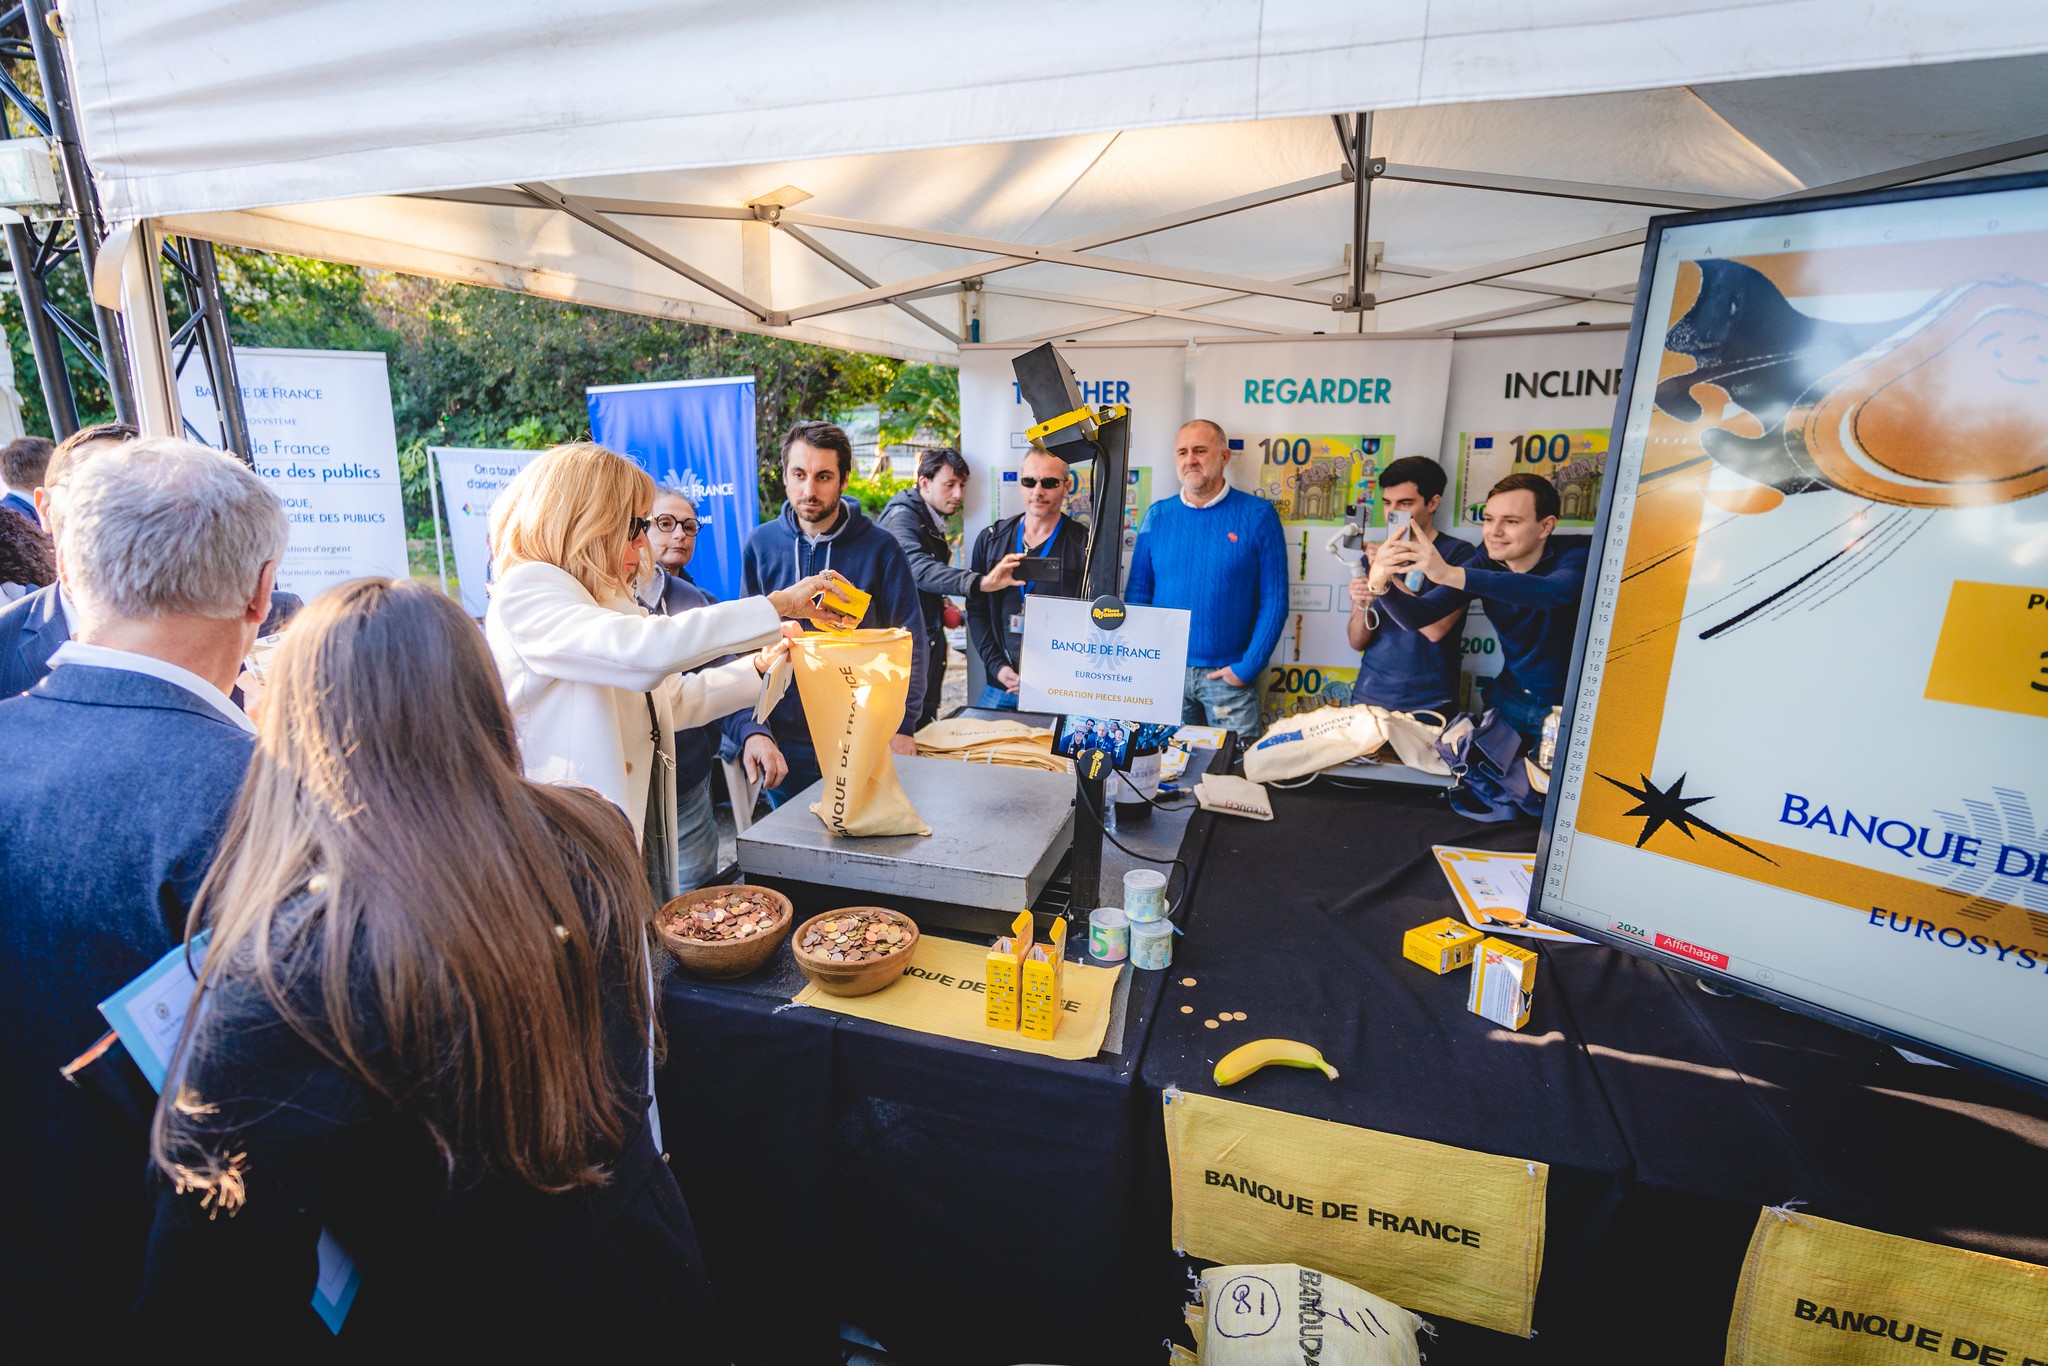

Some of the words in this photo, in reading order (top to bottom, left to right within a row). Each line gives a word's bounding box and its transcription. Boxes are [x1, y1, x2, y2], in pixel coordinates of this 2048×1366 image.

[1705, 246, 1712, 255] A
[1783, 239, 1791, 248] B
[253, 388, 269, 398] DE
[272, 387, 323, 399] FRANCE
[1012, 380, 1131, 404] THER
[1244, 378, 1392, 404] REGARDER
[253, 438, 268, 454] de
[274, 440, 331, 455] France
[1510, 433, 1571, 464] 100
[1258, 437, 1312, 466] 100
[287, 462, 316, 478] des
[322, 463, 381, 482] publics
[1253, 448, 1364, 497] pecimen
[1626, 469, 1632, 477] 5
[691, 483, 735, 498] FRANCE
[1624, 483, 1630, 491] 6
[1622, 497, 1628, 505] 7
[288, 512, 315, 523] CIÈRE
[319, 513, 340, 523] DES
[343, 513, 386, 523] PUBLICS
[1619, 511, 1625, 519] 8
[1616, 525, 1623, 533] 9
[1612, 538, 1623, 547] 10
[287, 545, 311, 553] stions
[1608, 558, 1619, 567] 11
[1605, 574, 1616, 583] 12
[1603, 588, 1614, 596] 13
[1601, 601, 1611, 609] 14
[2027, 594, 2048, 610] P
[1598, 614, 1608, 623] 15
[1460, 637, 1496, 654] 200
[1594, 638, 1605, 646] 16
[1051, 639, 1097, 655] BANQUE
[1100, 644, 1114, 656] DE
[1116, 645, 1161, 660] FRANCE
[1592, 651, 1602, 659] 17
[1075, 670, 1133, 683] EUROSYSTÈME
[1269, 667, 1321, 694] 200
[1587, 676, 1598, 685] 19
[1047, 688, 1093, 699] OPERATION
[1095, 692, 1122, 702] PIECES
[1123, 694, 1154, 706] JAUNES
[1584, 689, 1595, 697] 20
[839, 666, 860, 735] FRACE
[1581, 702, 1592, 710] 21
[1579, 714, 1590, 722] 22
[1577, 727, 1588, 735] 23
[1574, 739, 1586, 747] 24
[841, 743, 850, 768] DE
[1572, 751, 1583, 759] 25
[1570, 763, 1581, 772] 26
[1568, 775, 1579, 784] 27
[1565, 792, 1576, 801] 28
[832, 776, 853, 837] ANQUE
[1560, 820, 1571, 828] 29
[1778, 792, 1983, 868] BANQUE
[1557, 835, 1568, 843] 30
[1555, 849, 1565, 858] 31
[1552, 864, 1563, 872] 32
[1549, 878, 1560, 886] 33
[1616, 921, 1646, 938] 2024
[1092, 925, 1109, 958] 5
[1868, 906, 2048, 974] EUROSYS
[1663, 937, 1719, 963] Affichage
[903, 966, 955, 987] NQUE
[958, 980, 987, 994] DE
[1205, 1169, 1314, 1216] BANQUE
[1321, 1201, 1359, 1222] DE
[1368, 1208, 1481, 1249] FRANCE
[1794, 1298, 1942, 1353] BANQUE
[1951, 1337, 2008, 1366] DE
